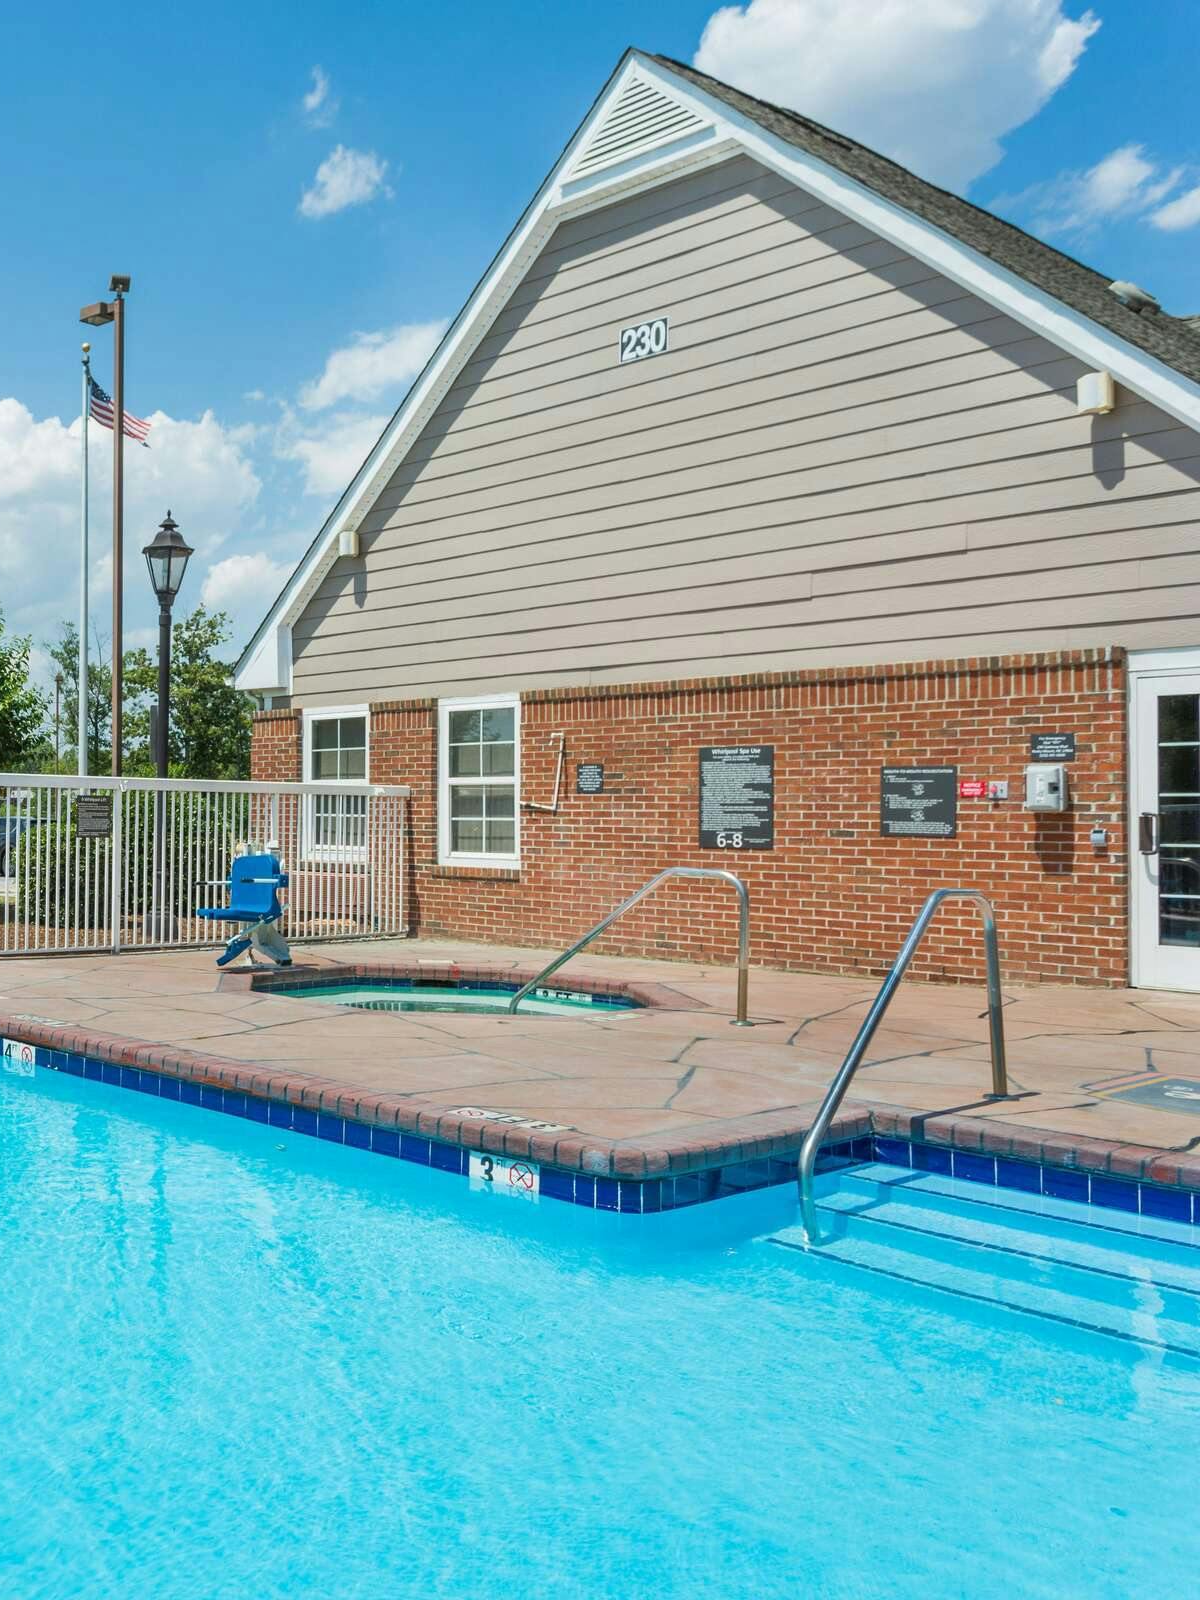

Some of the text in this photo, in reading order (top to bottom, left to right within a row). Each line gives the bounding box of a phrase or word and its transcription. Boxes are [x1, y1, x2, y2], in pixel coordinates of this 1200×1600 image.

[622, 320, 666, 361] 230
[716, 833, 743, 848] 6-8
[5, 1043, 12, 1057] 4
[480, 1156, 494, 1181] 3
